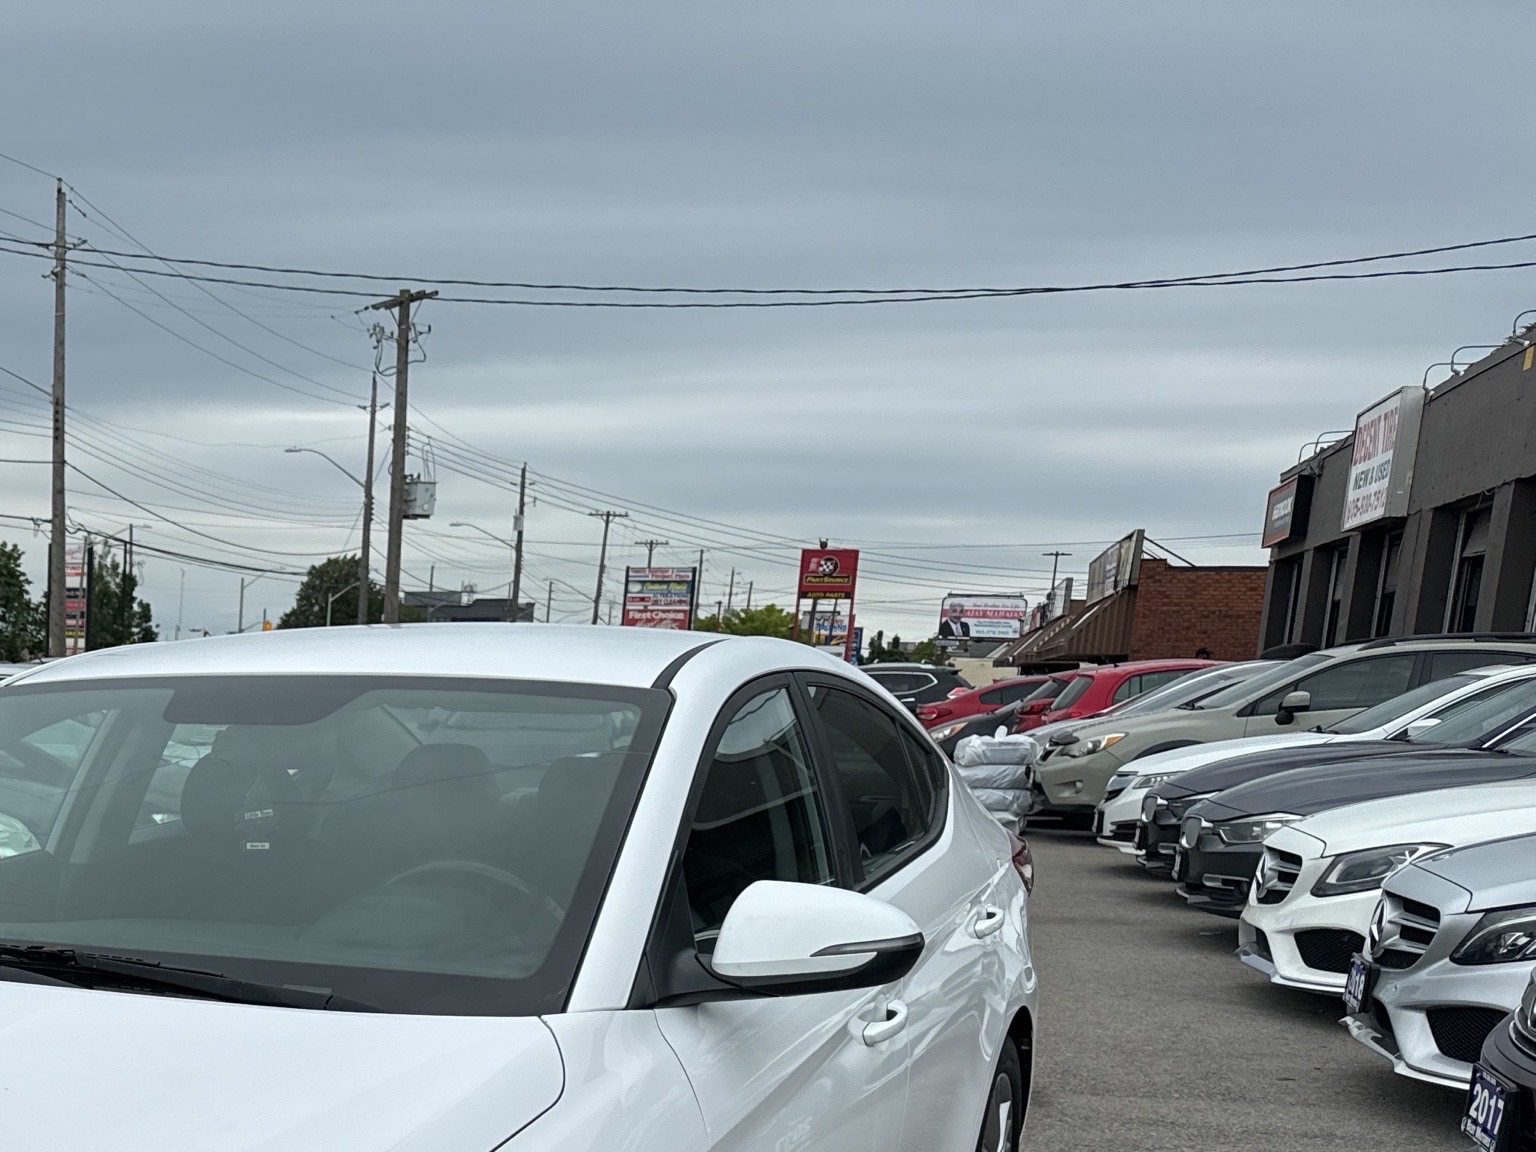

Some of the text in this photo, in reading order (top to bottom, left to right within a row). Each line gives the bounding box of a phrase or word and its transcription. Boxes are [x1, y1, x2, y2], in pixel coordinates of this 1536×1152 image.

[1352, 414, 1382, 467] DECENT
[1352, 468, 1368, 492] NEW
[629, 610, 684, 619] First Choice
[1469, 1082, 1504, 1135] 2017
